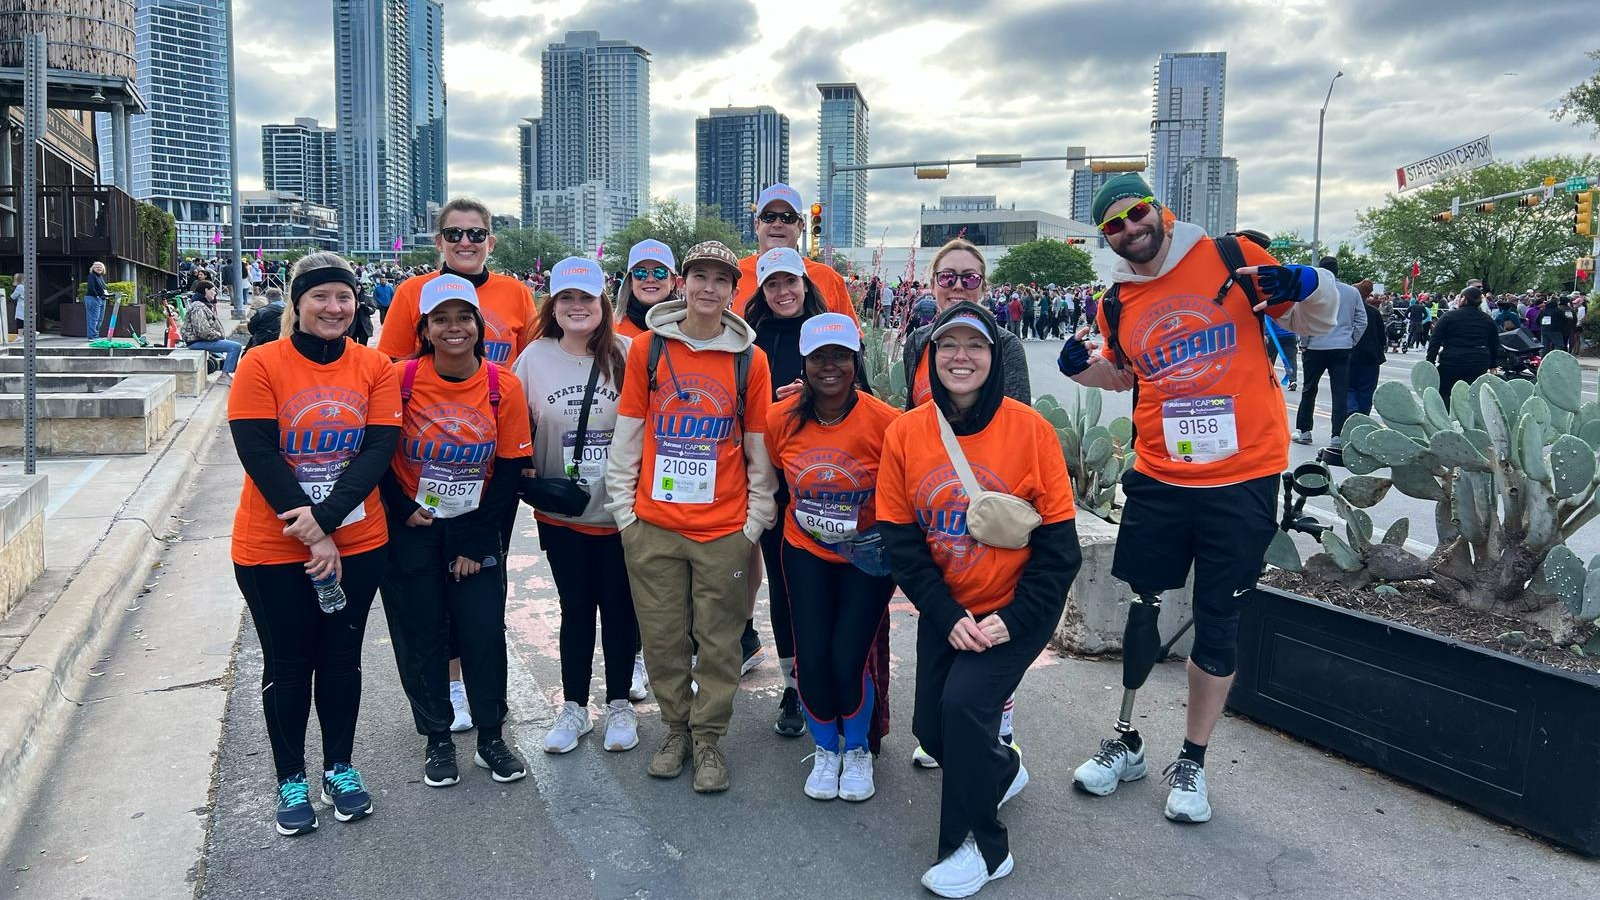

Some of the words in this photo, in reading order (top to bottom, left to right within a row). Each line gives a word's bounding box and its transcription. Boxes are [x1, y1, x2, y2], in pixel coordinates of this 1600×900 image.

[1407, 153, 1457, 182] STATESMAN
[1456, 138, 1491, 164] CAP10K
[703, 247, 730, 260] YETI
[1195, 398, 1226, 407] CAP10K
[1179, 418, 1218, 435] 9158
[684, 443, 711, 451] CAP10K
[1181, 444, 1188, 452] F
[663, 458, 707, 477] 21096
[427, 481, 477, 497] 20857
[664, 479, 670, 488] F
[824, 503, 852, 512] CAP10K
[806, 515, 845, 534] 8400
